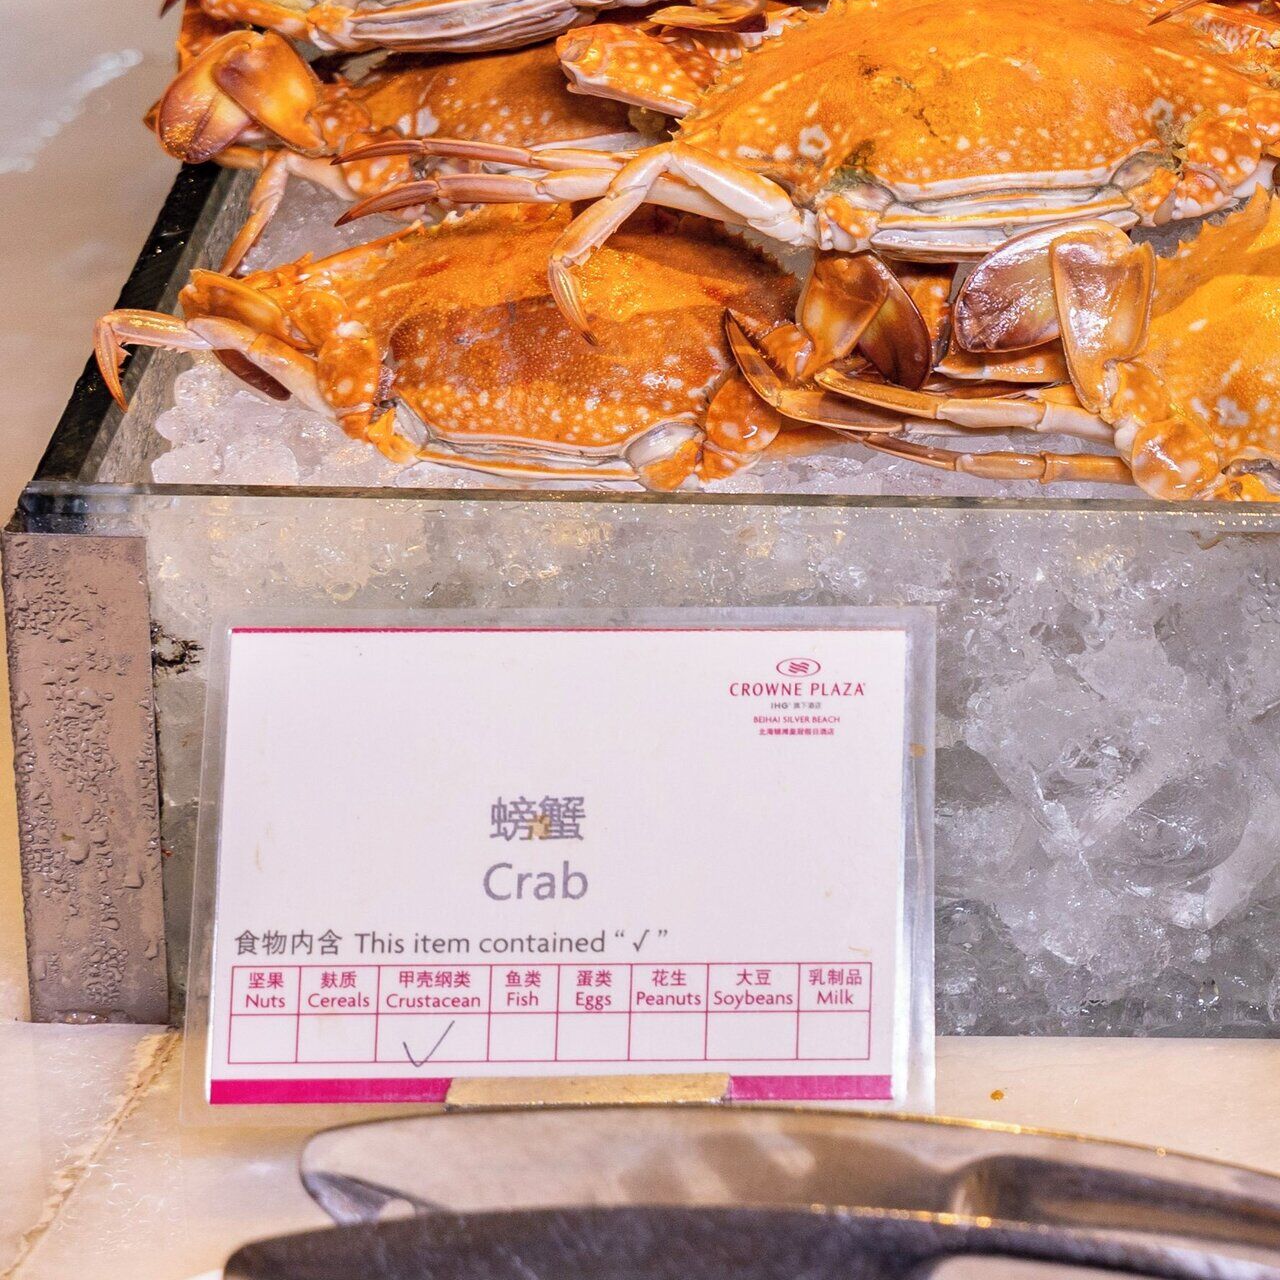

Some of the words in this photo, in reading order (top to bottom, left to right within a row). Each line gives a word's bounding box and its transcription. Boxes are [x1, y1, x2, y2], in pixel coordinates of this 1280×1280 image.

[730, 683, 801, 696] CROWNE
[811, 683, 865, 696] PLAZA
[490, 795, 586, 841] 螃蟹
[483, 860, 588, 901] Crab
[235, 929, 342, 955] 食物内含
[354, 931, 404, 953] This
[415, 933, 469, 953] item
[479, 930, 605, 953] contained
[249, 972, 283, 989] 坚果
[399, 970, 470, 988] 甲壳纲类
[505, 970, 541, 987] 鱼类
[577, 970, 612, 987] 蛋类
[652, 969, 686, 986] 花生
[736, 969, 771, 986] 大豆
[809, 968, 862, 985] 乳制品
[246, 994, 285, 1008] Nuts
[308, 992, 369, 1008] Cereals
[386, 993, 480, 1008] Crustacean
[507, 991, 538, 1006] Fish
[576, 992, 613, 1012] Eggs
[637, 991, 701, 1006] Peanuts
[714, 990, 793, 1010] Soybeans
[817, 989, 853, 1004] Milk
